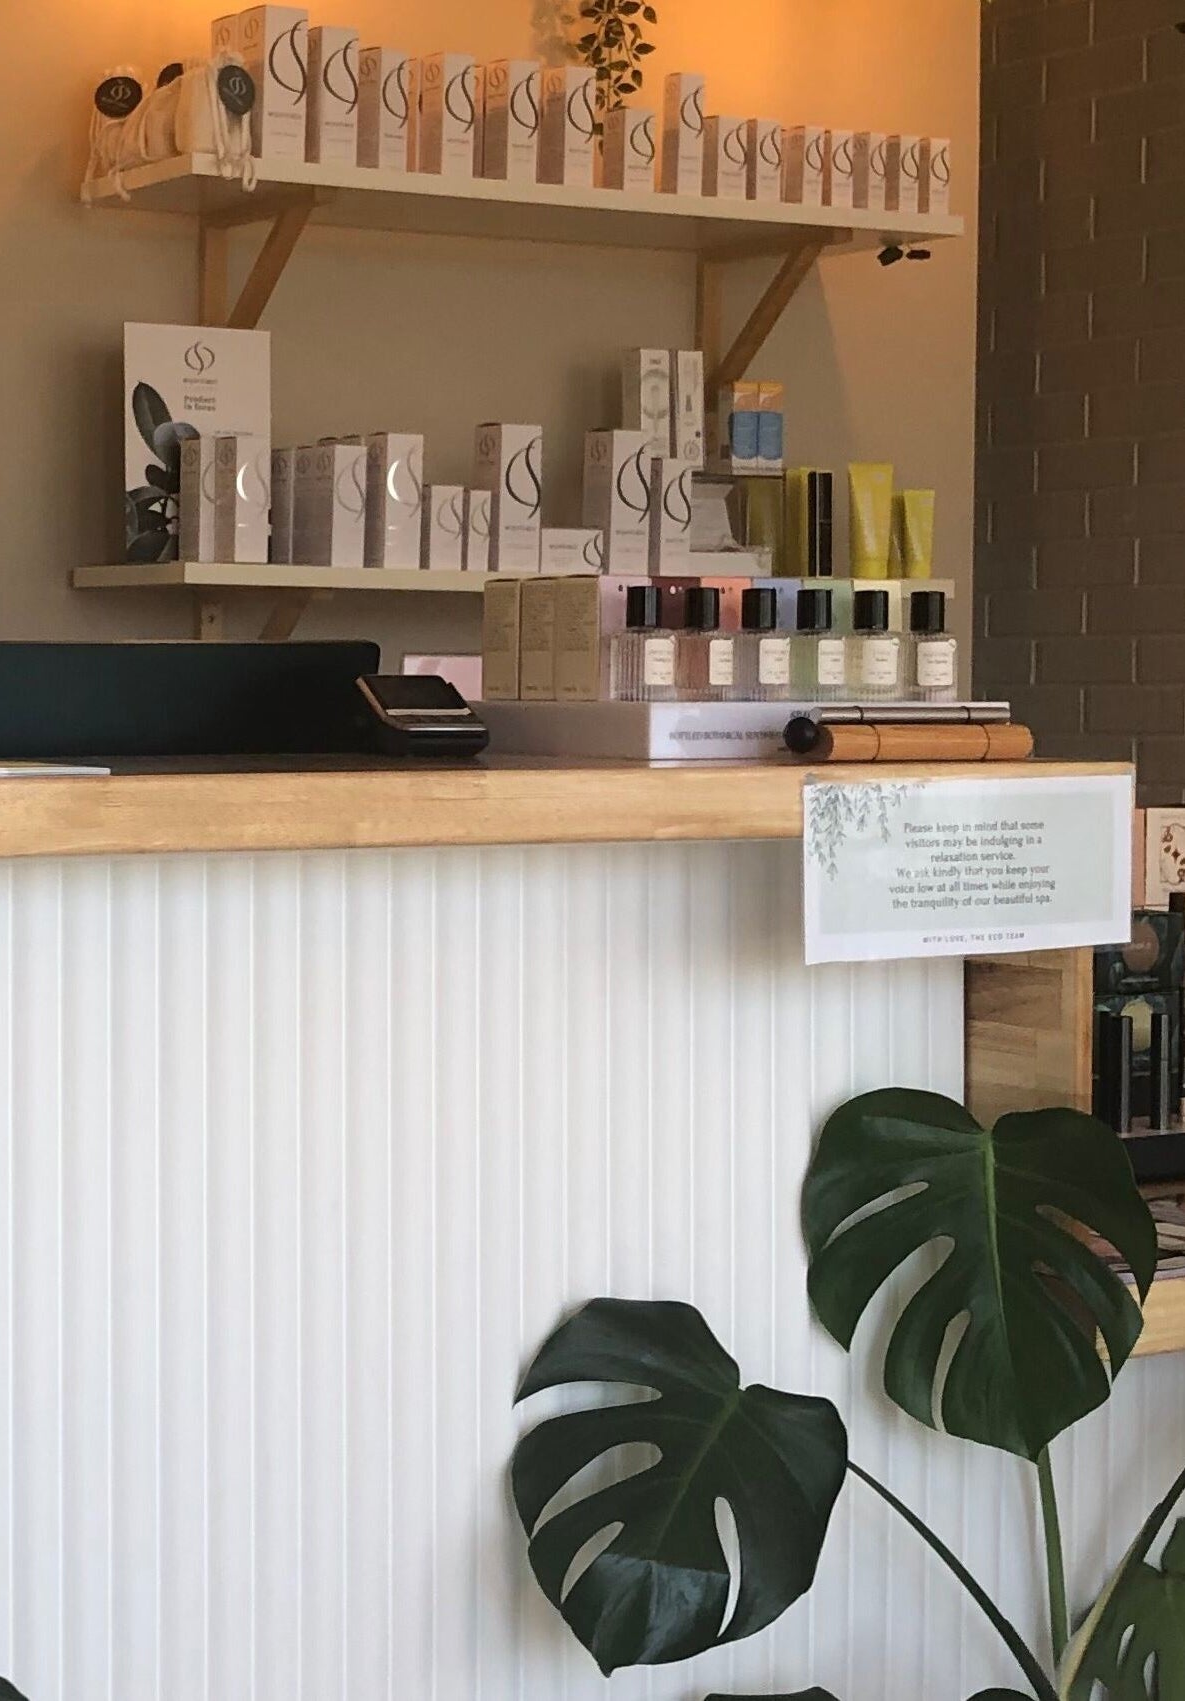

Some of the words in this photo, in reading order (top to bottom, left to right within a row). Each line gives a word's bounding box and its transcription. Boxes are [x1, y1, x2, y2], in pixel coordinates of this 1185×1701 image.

[904, 822, 933, 833] Please
[936, 821, 959, 834] keep
[962, 822, 971, 832] in
[975, 821, 997, 831] mind
[1000, 820, 1018, 831] that
[1020, 821, 1044, 831] some
[905, 837, 940, 848] visitors
[943, 838, 962, 849] may
[966, 836, 978, 847] be
[980, 835, 1023, 848] indulging
[1026, 835, 1035, 845] in
[931, 851, 978, 862] relaxation
[980, 851, 1015, 861] service.
[897, 867, 911, 878] We
[933, 865, 961, 878] kindly
[965, 865, 983, 876] that
[985, 866, 1003, 878] you
[1006, 864, 1027, 876] keep
[1030, 865, 1049, 876] your
[889, 882, 914, 894] voice
[917, 882, 933, 893] low
[937, 882, 946, 892] at
[949, 881, 960, 891] all
[963, 881, 988, 891] times
[992, 880, 1015, 890] while
[1018, 879, 1055, 890] enjoying
[892, 898, 908, 909] the
[911, 896, 959, 910] tranquility
[962, 896, 972, 906] of
[975, 897, 990, 905] our
[993, 893, 1033, 905] beautiful
[923, 935, 942, 943] WITH
[971, 934, 985, 942] THE
[1006, 932, 1025, 940] TEAM
